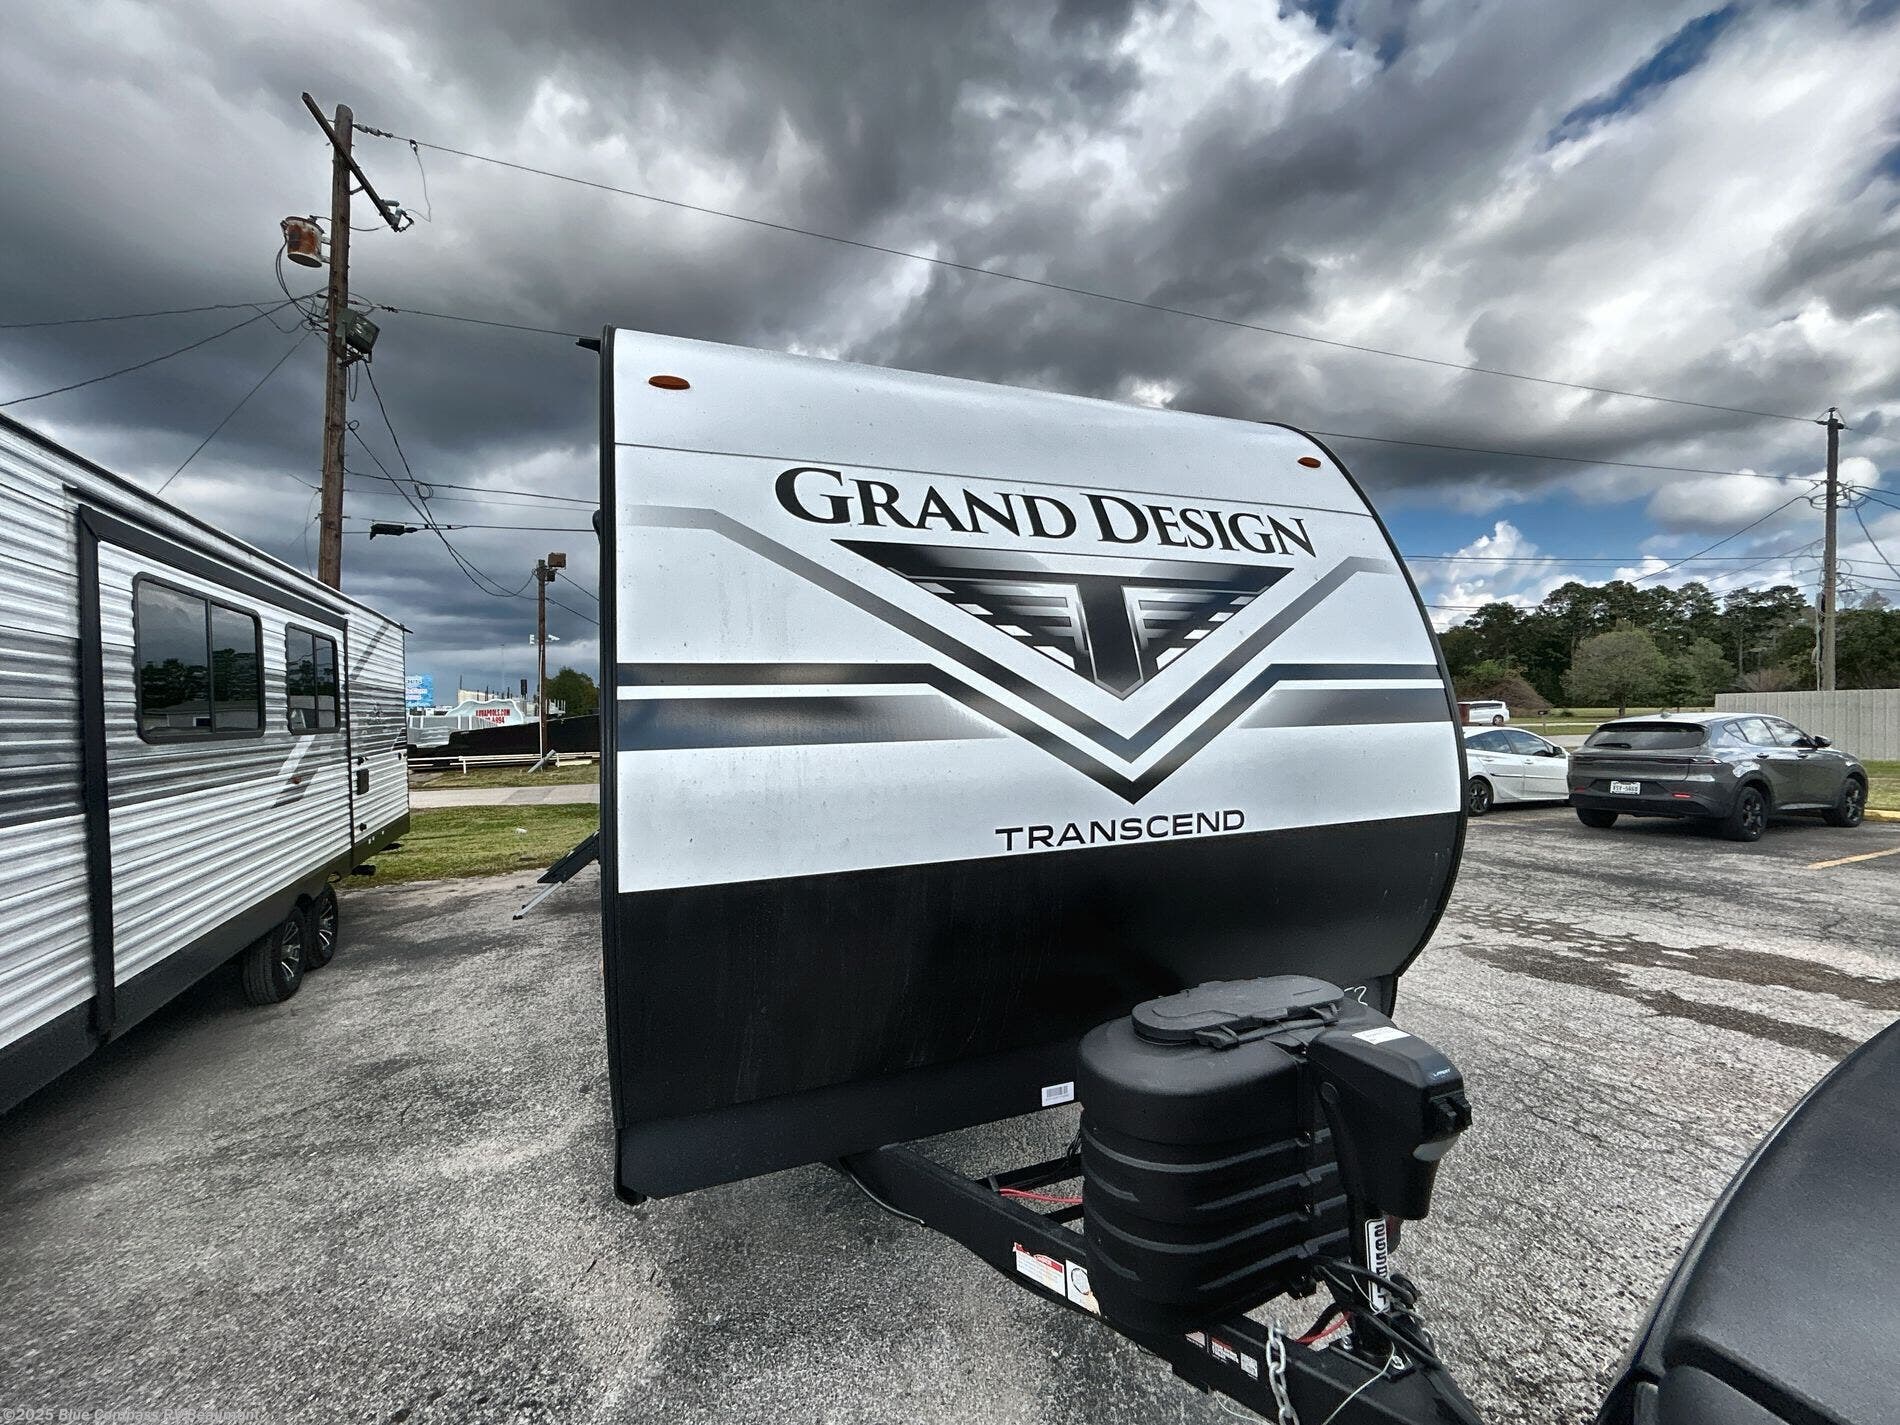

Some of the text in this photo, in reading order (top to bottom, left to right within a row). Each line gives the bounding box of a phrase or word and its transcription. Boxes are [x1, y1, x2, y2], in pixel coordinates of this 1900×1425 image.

[775, 467, 1316, 558] GRAND DESIGN
[995, 809, 1245, 851] TRANSCEND
